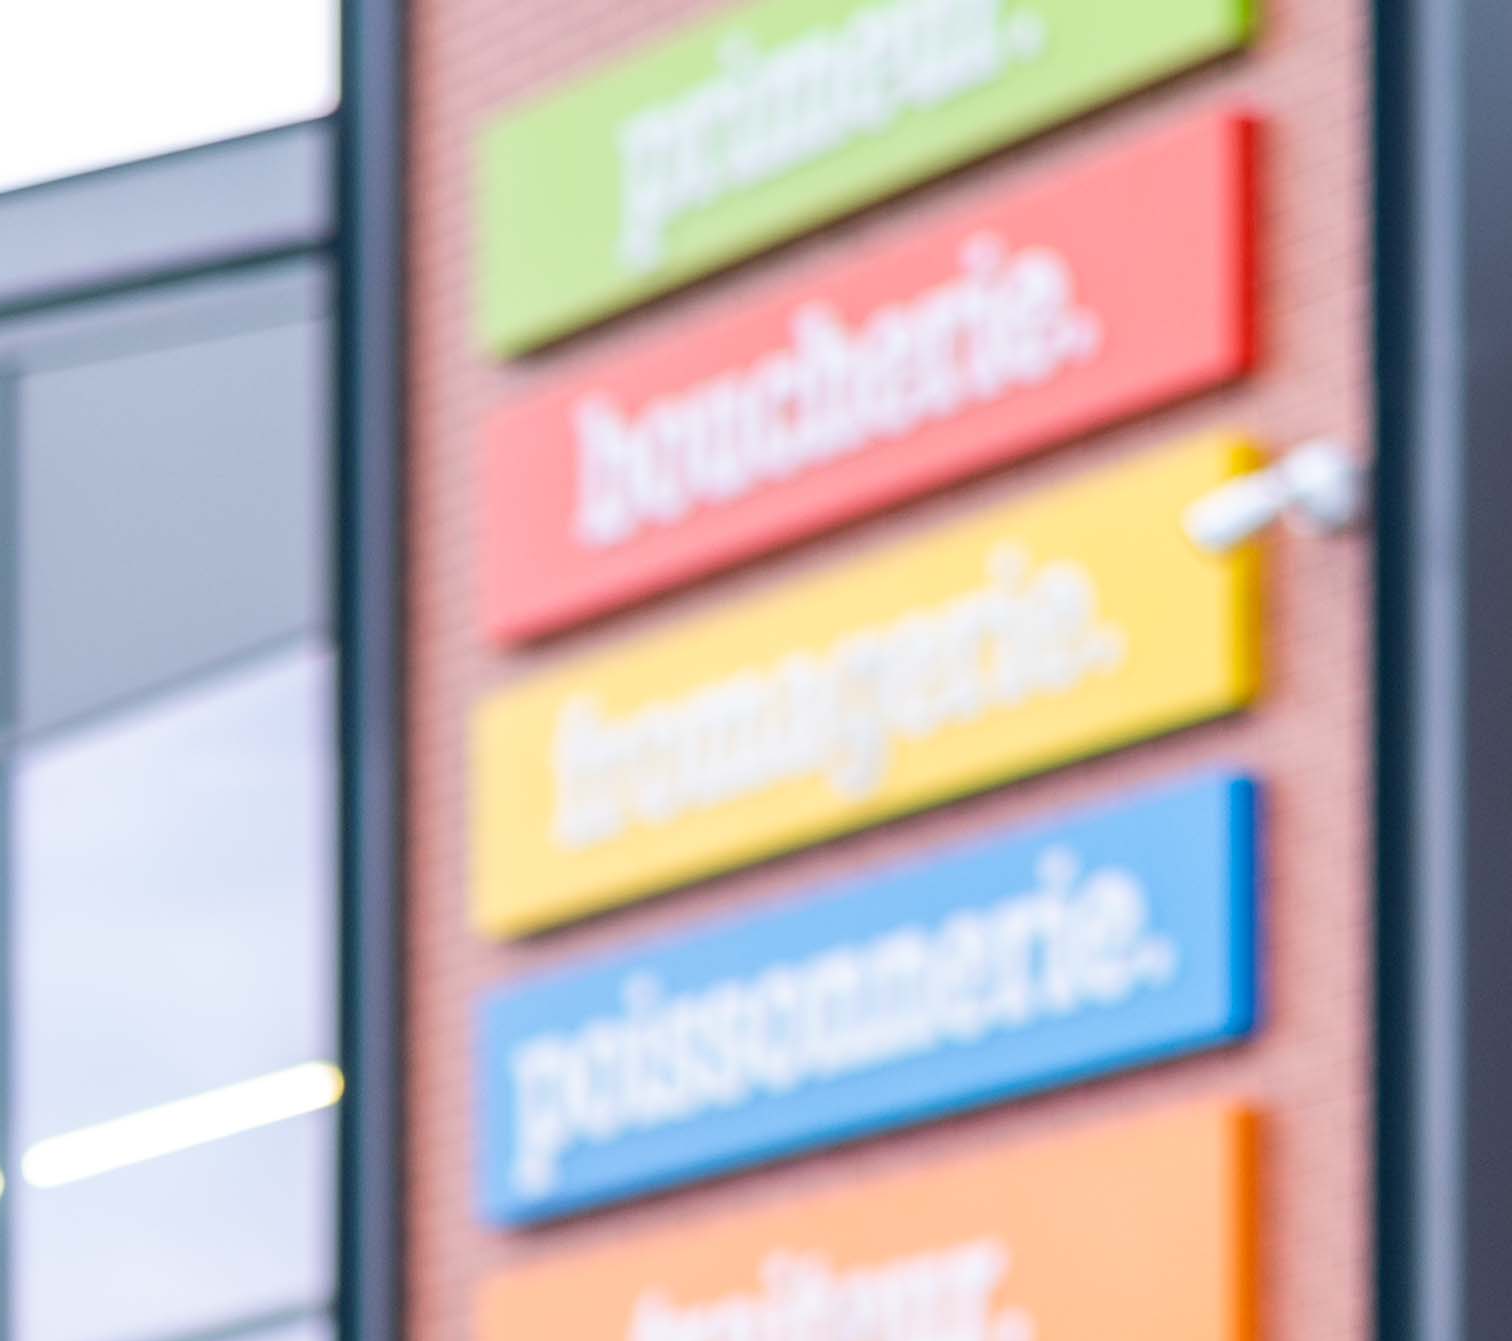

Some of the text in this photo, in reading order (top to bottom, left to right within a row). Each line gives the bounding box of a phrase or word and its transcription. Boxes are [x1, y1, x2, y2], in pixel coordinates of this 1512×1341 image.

[571, 233, 1100, 543] boucherie.
[550, 543, 1124, 846] fromagerie.
[510, 846, 1176, 1193] poissonnerie.
